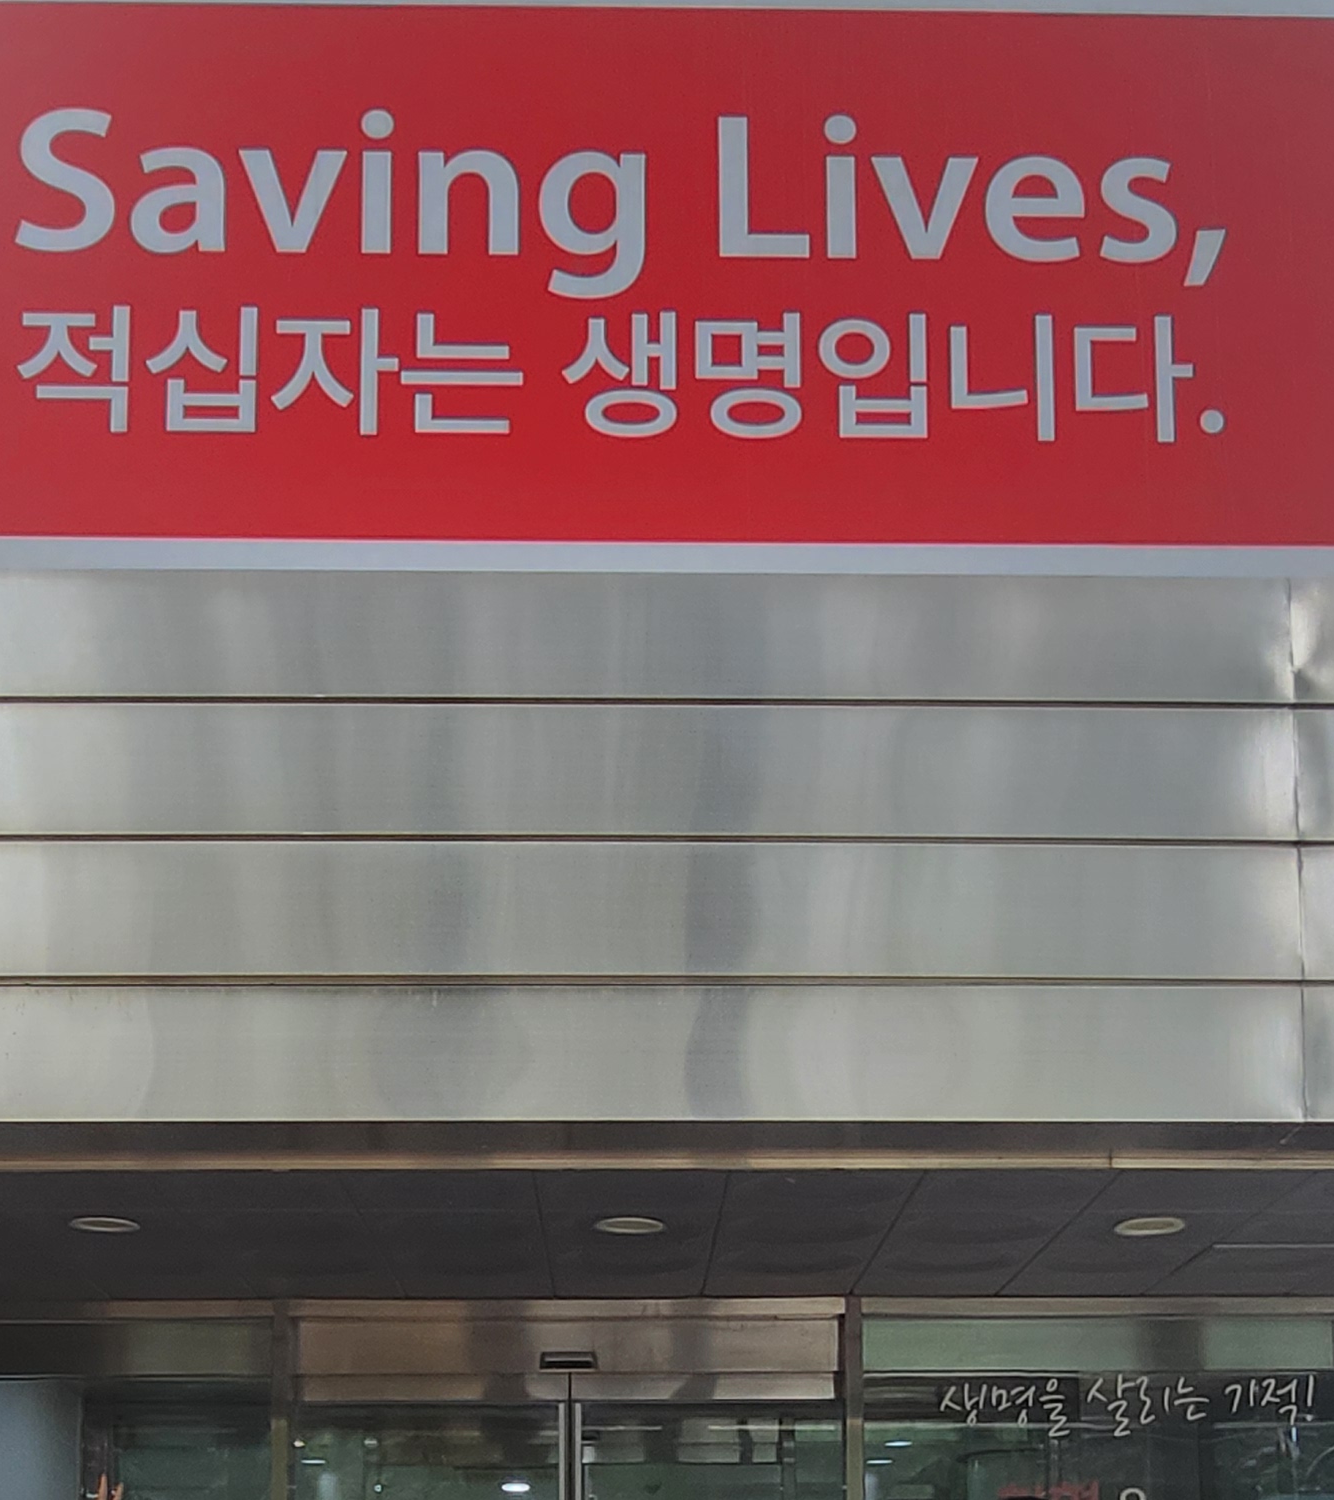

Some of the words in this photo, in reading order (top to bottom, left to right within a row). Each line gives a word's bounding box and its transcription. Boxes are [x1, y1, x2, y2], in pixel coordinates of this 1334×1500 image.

[14, 107, 646, 299] Saving
[717, 112, 1227, 287] Lives,
[16, 304, 523, 435] 적십자는
[561, 310, 1227, 442] 생명입니다.
[940, 1378, 1071, 1437] 생명을
[1086, 1373, 1210, 1437] 살리는
[1224, 1374, 1315, 1426] 기적!
